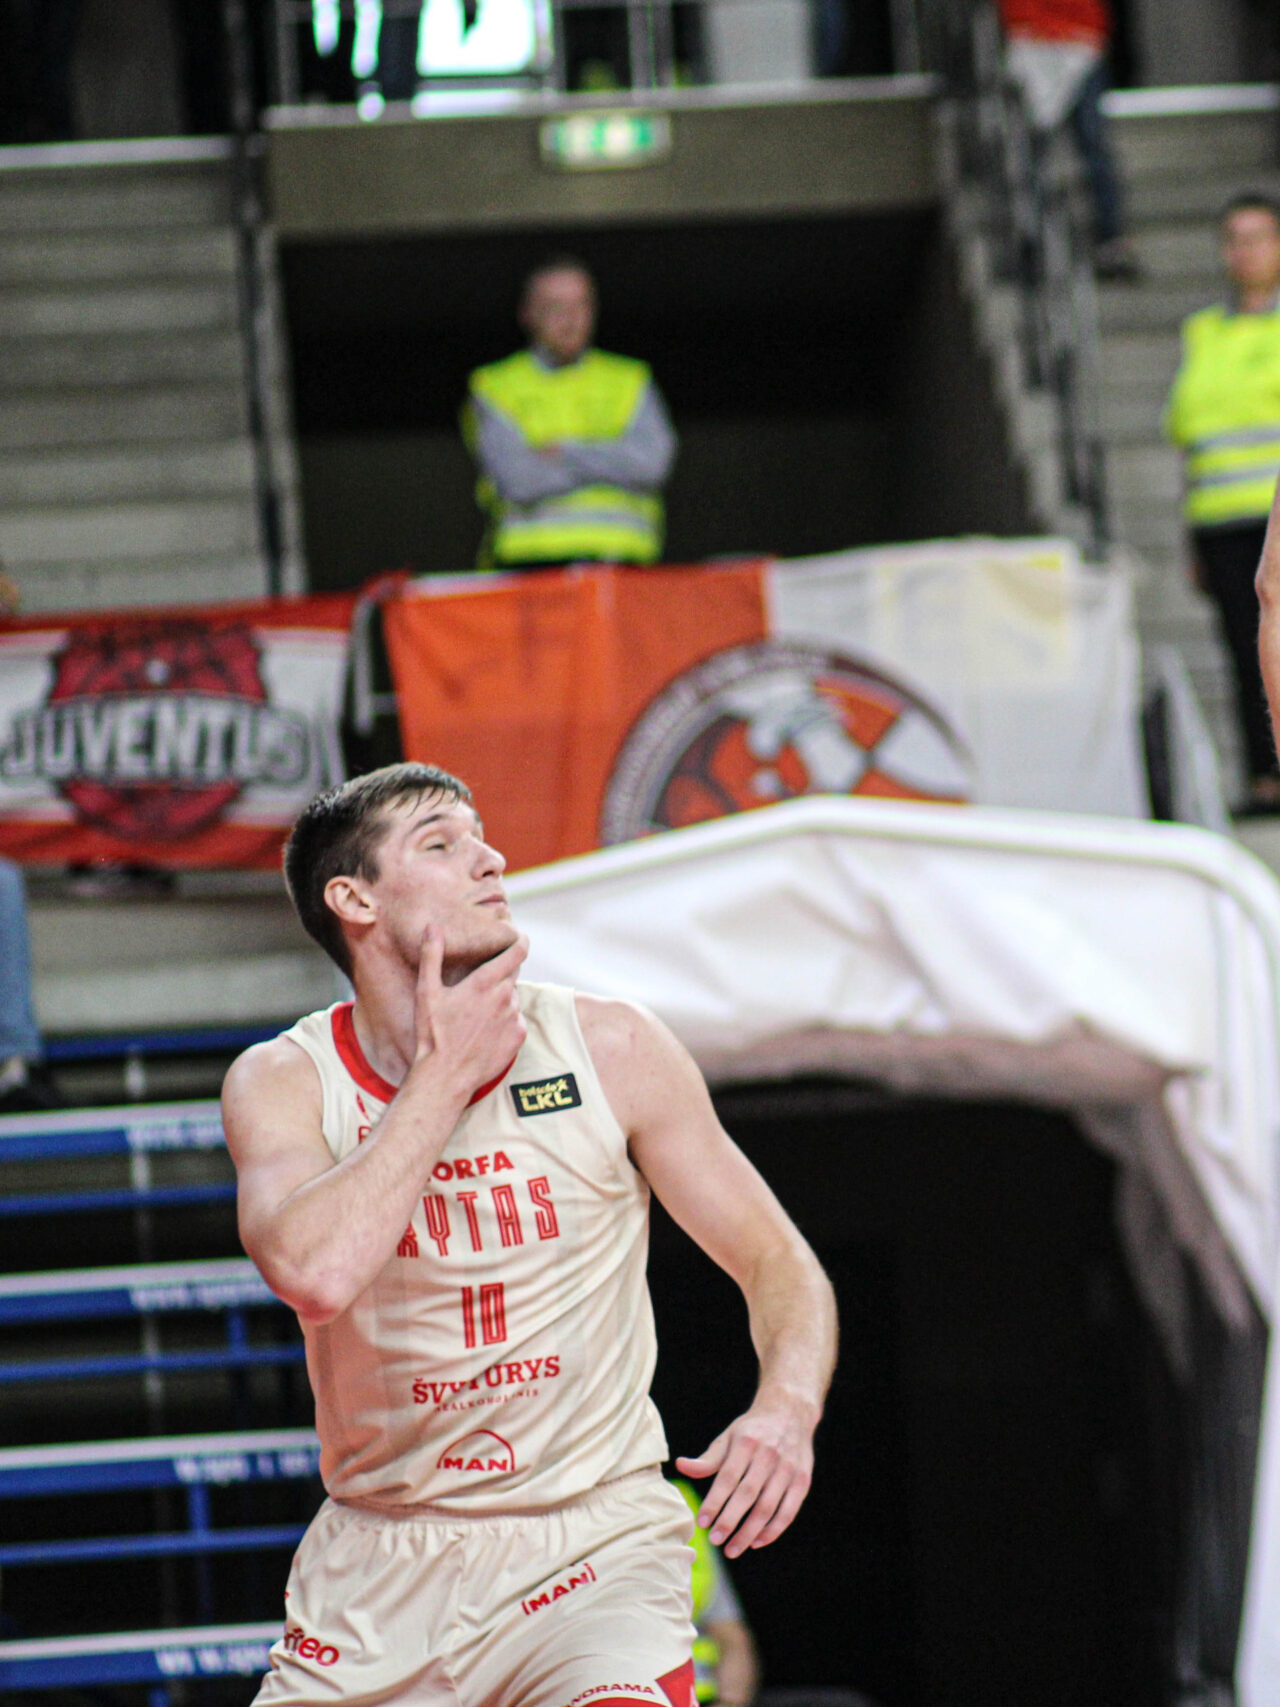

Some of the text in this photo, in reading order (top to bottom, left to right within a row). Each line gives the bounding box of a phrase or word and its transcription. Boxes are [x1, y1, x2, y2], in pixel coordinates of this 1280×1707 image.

[520, 1091, 573, 1112] LKL
[427, 1150, 515, 1182] ORFA
[461, 1282, 507, 1349] 10
[443, 1457, 508, 1472] MAN
[530, 1570, 588, 1614] MAN
